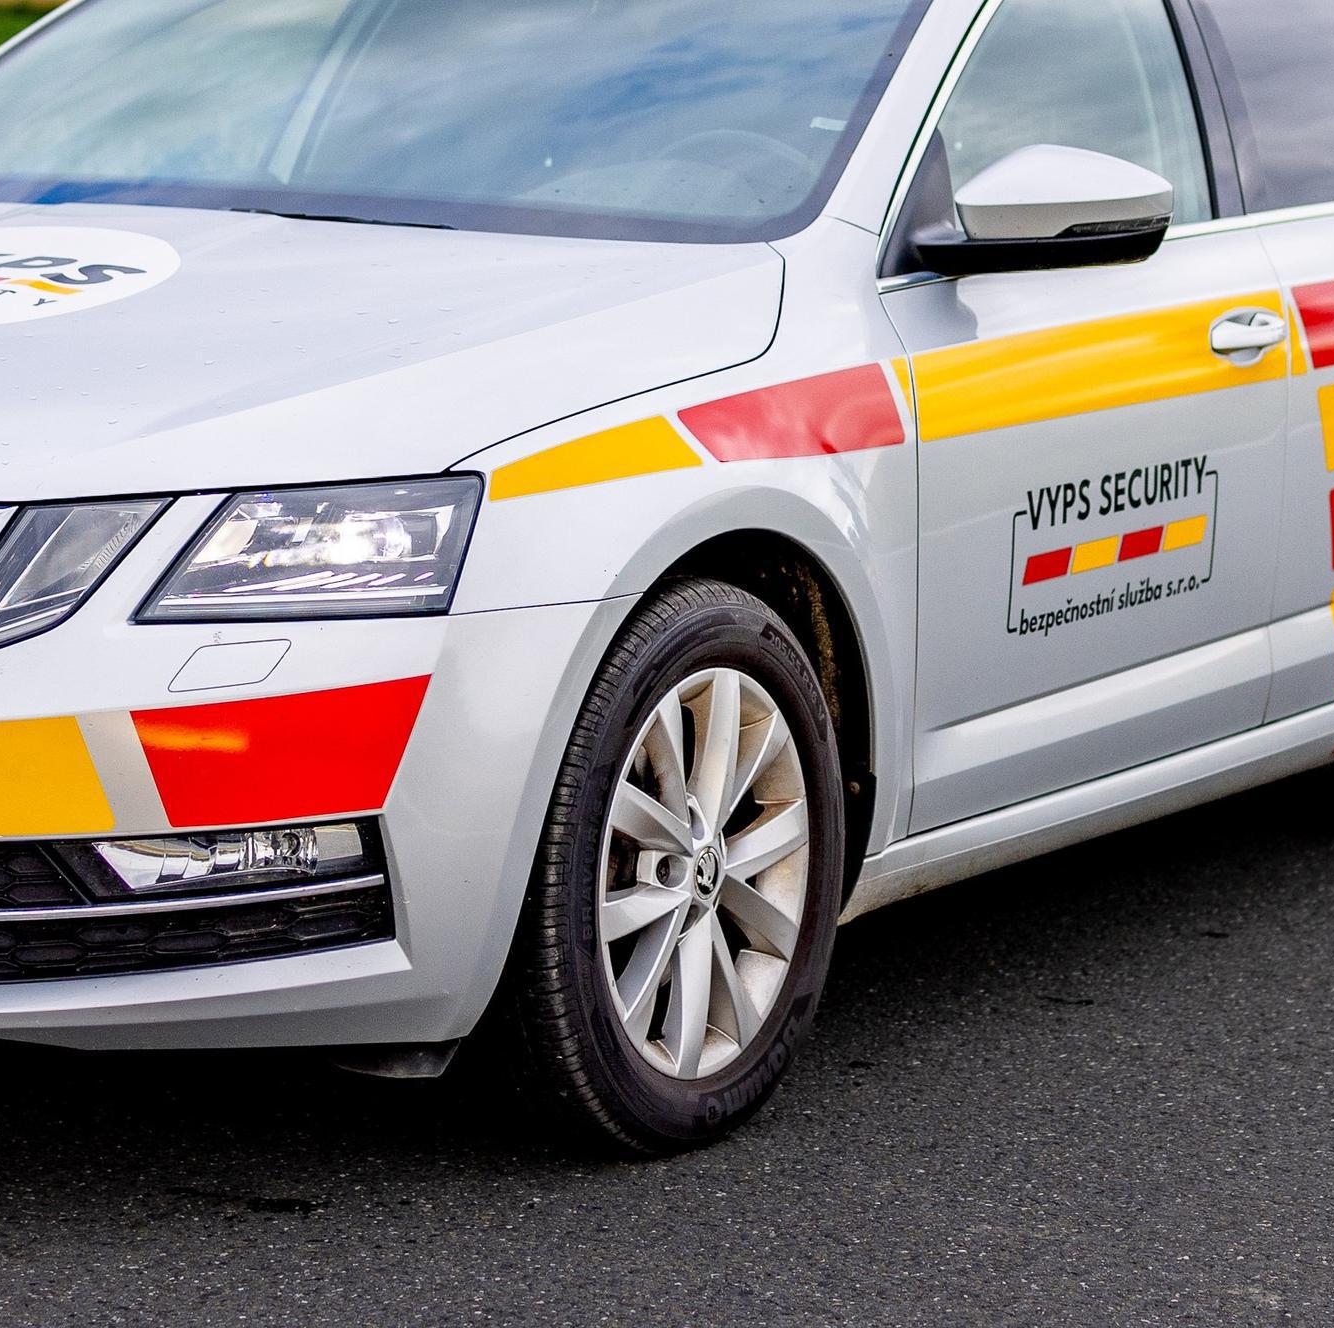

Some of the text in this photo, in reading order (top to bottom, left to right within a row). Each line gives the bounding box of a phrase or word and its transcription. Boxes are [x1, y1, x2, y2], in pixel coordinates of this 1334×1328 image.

[1027, 455, 1207, 530] VYPS SECURITY
[1019, 574, 1201, 637] bezpečnostní služba s.r.o.
